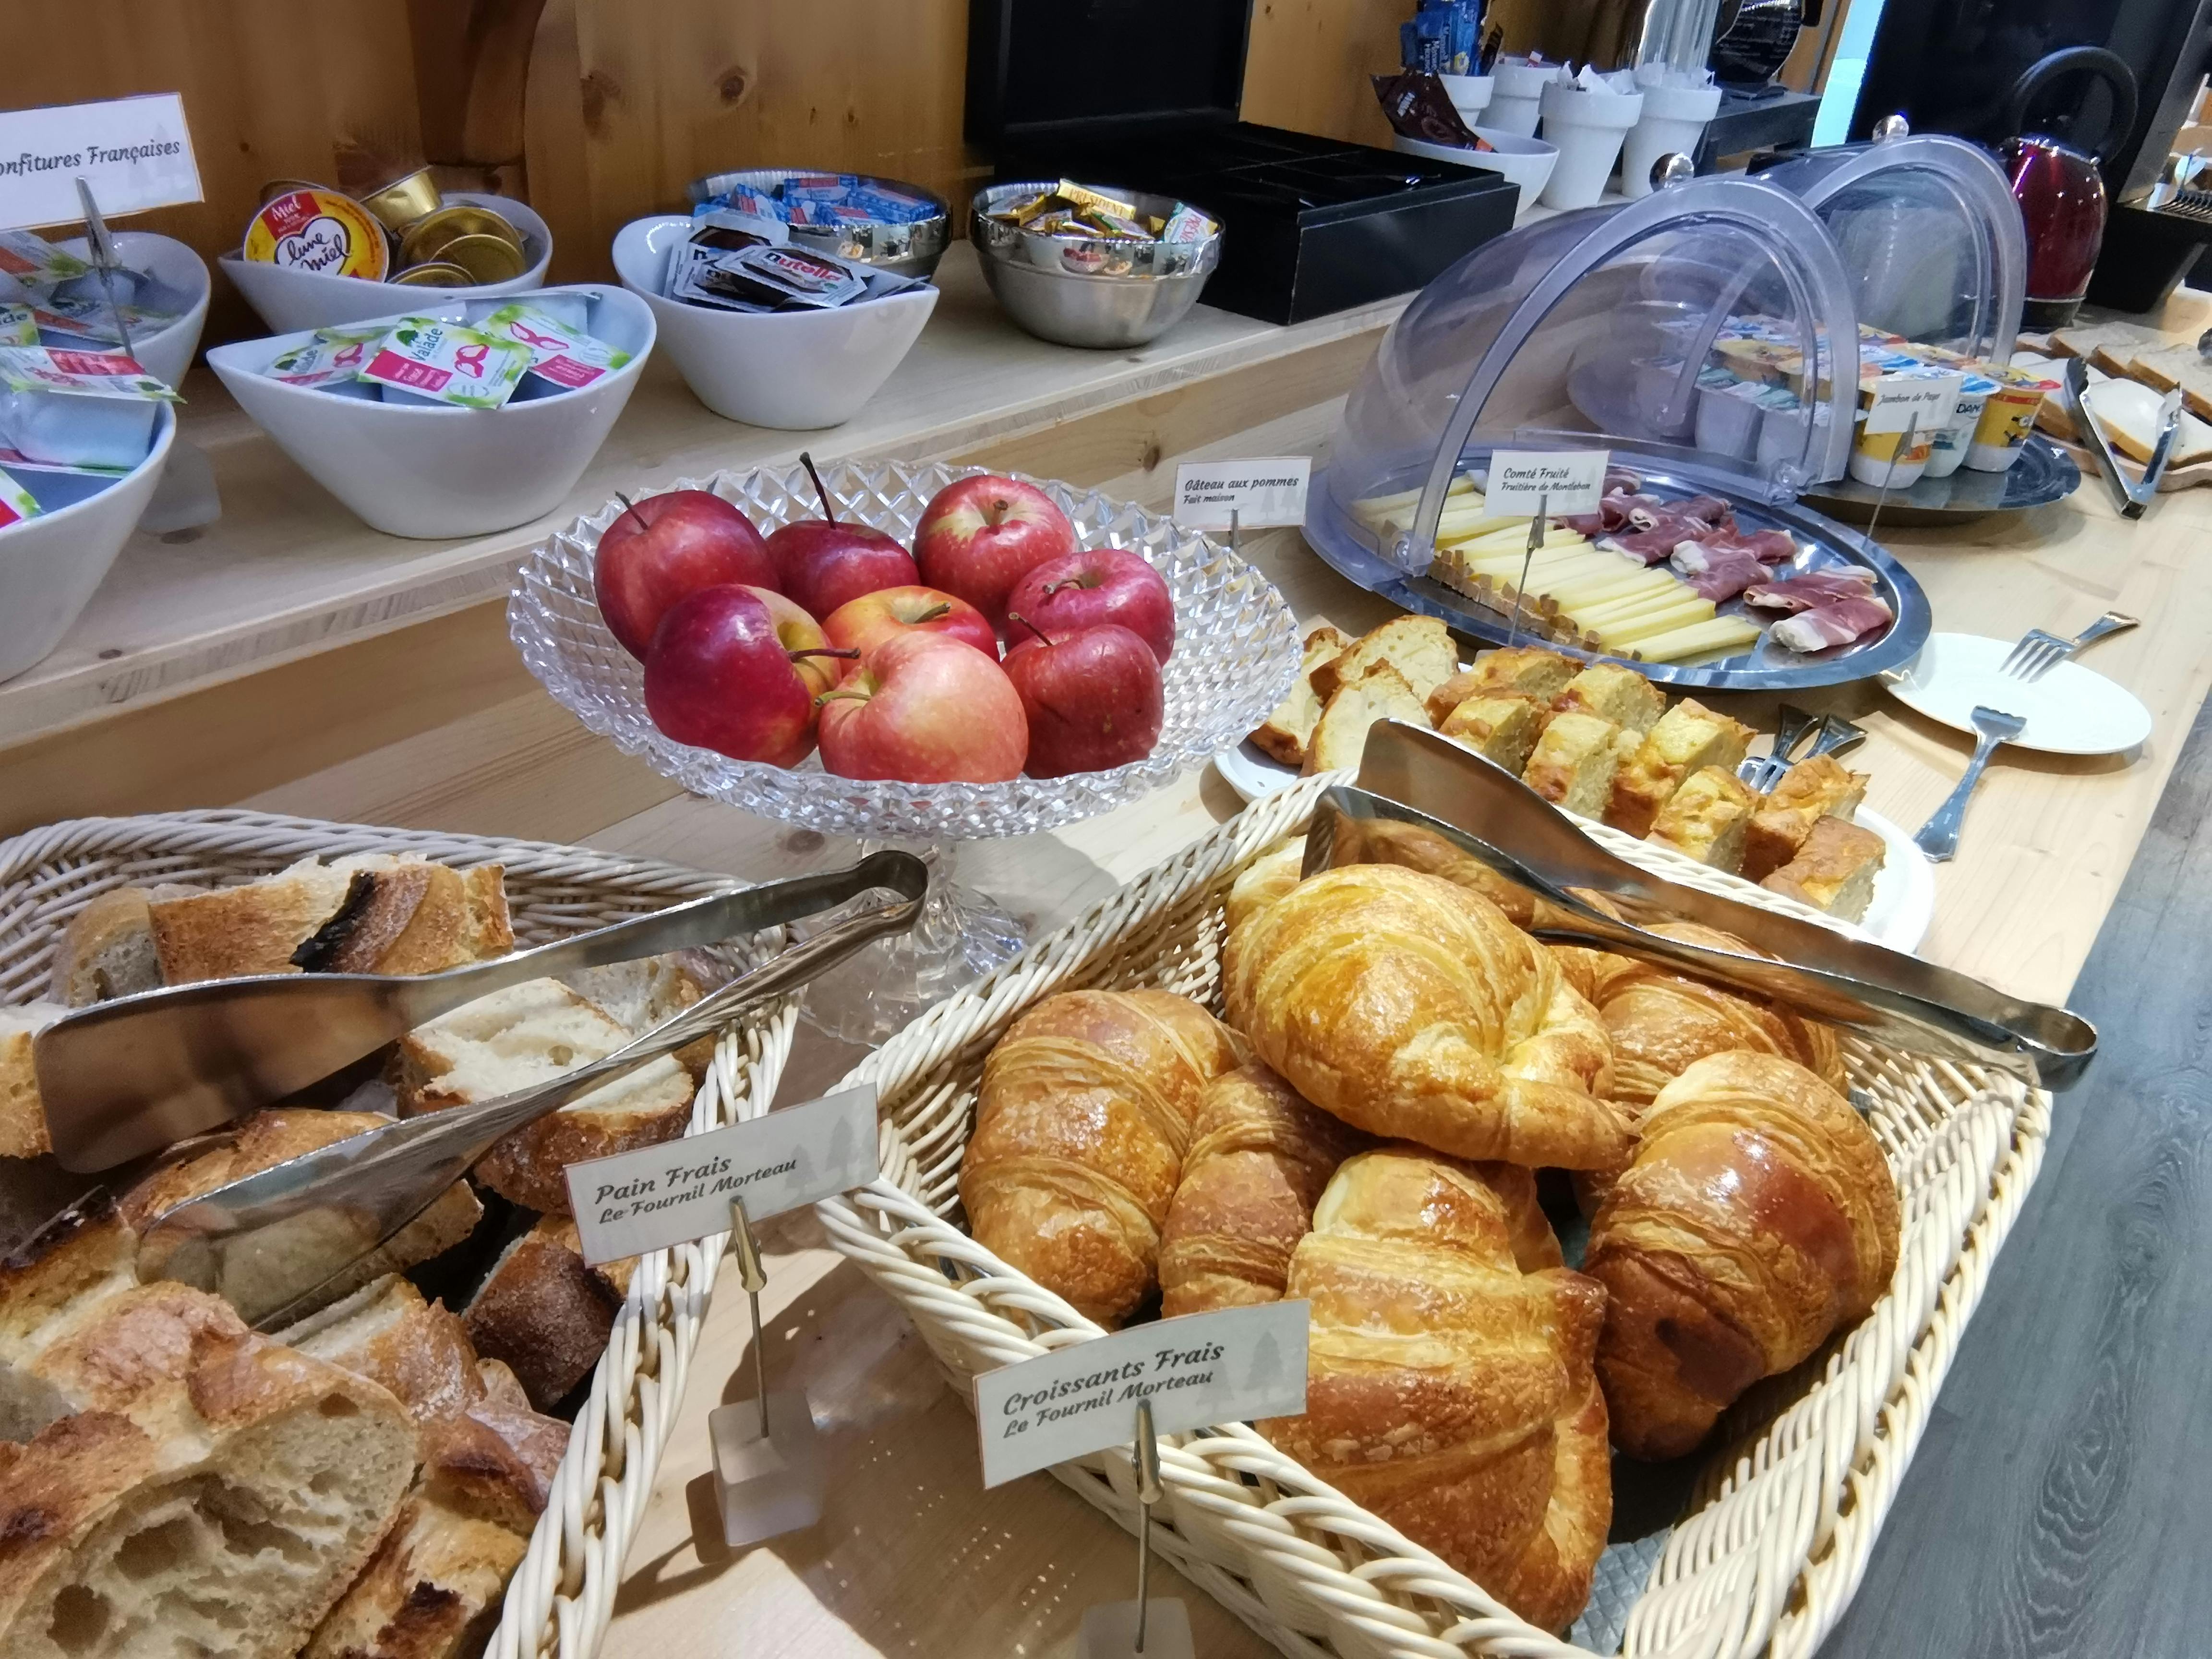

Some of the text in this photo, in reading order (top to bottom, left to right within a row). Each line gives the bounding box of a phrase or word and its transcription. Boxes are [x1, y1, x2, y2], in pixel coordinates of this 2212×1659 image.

[0, 139, 180, 176] onfitures Françaises
[765, 252, 842, 281] nutella
[408, 328, 443, 361] Valade
[1877, 394, 1910, 406] Jambon
[1911, 392, 1922, 402] de
[1956, 403, 1982, 414] DAN
[1185, 477, 1299, 491] Gâteau aux pommes
[1501, 481, 1536, 491] Fruitière
[1538, 481, 1549, 491] de
[1503, 467, 1570, 479] Comté Fruité
[1183, 493, 1235, 504] Fait maison
[595, 1156, 732, 1204] Pain Frais
[599, 1159, 796, 1225] Le Fournil Morteau
[1003, 1342, 1225, 1416] Croissants Frais
[1003, 1370, 1214, 1439] Le Fournil Morteau
